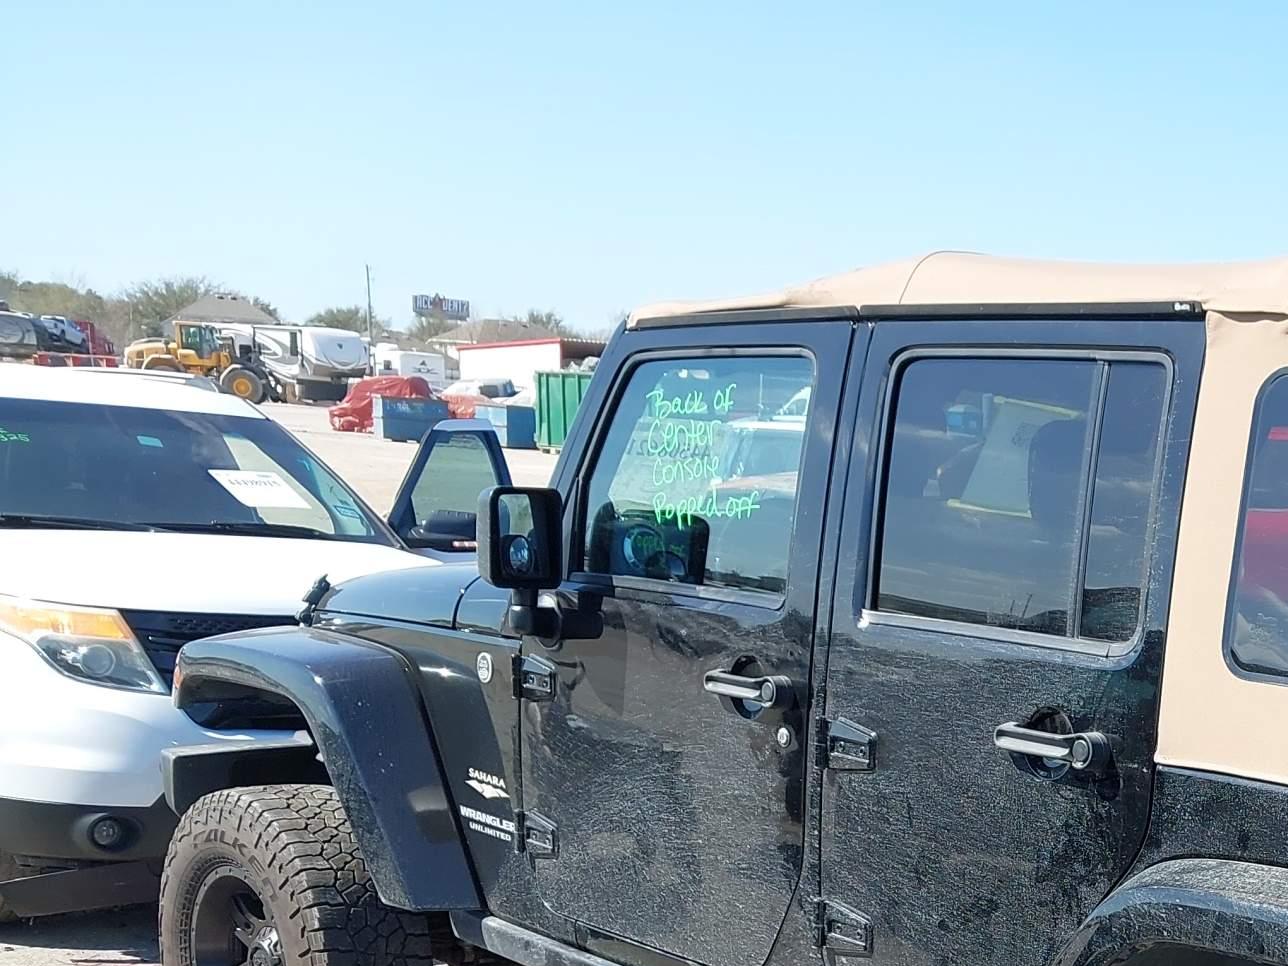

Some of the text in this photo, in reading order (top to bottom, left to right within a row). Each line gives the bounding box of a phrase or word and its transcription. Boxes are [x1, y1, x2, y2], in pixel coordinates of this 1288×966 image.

[646, 384, 736, 419] Back of
[648, 419, 721, 453] Center
[653, 457, 720, 486] Console
[653, 488, 720, 530] Popped
[468, 767, 506, 789] SAHARA
[459, 804, 516, 832] WRANGLER
[469, 822, 512, 842] UNLIMITED
[193, 828, 279, 902] FALKEN
